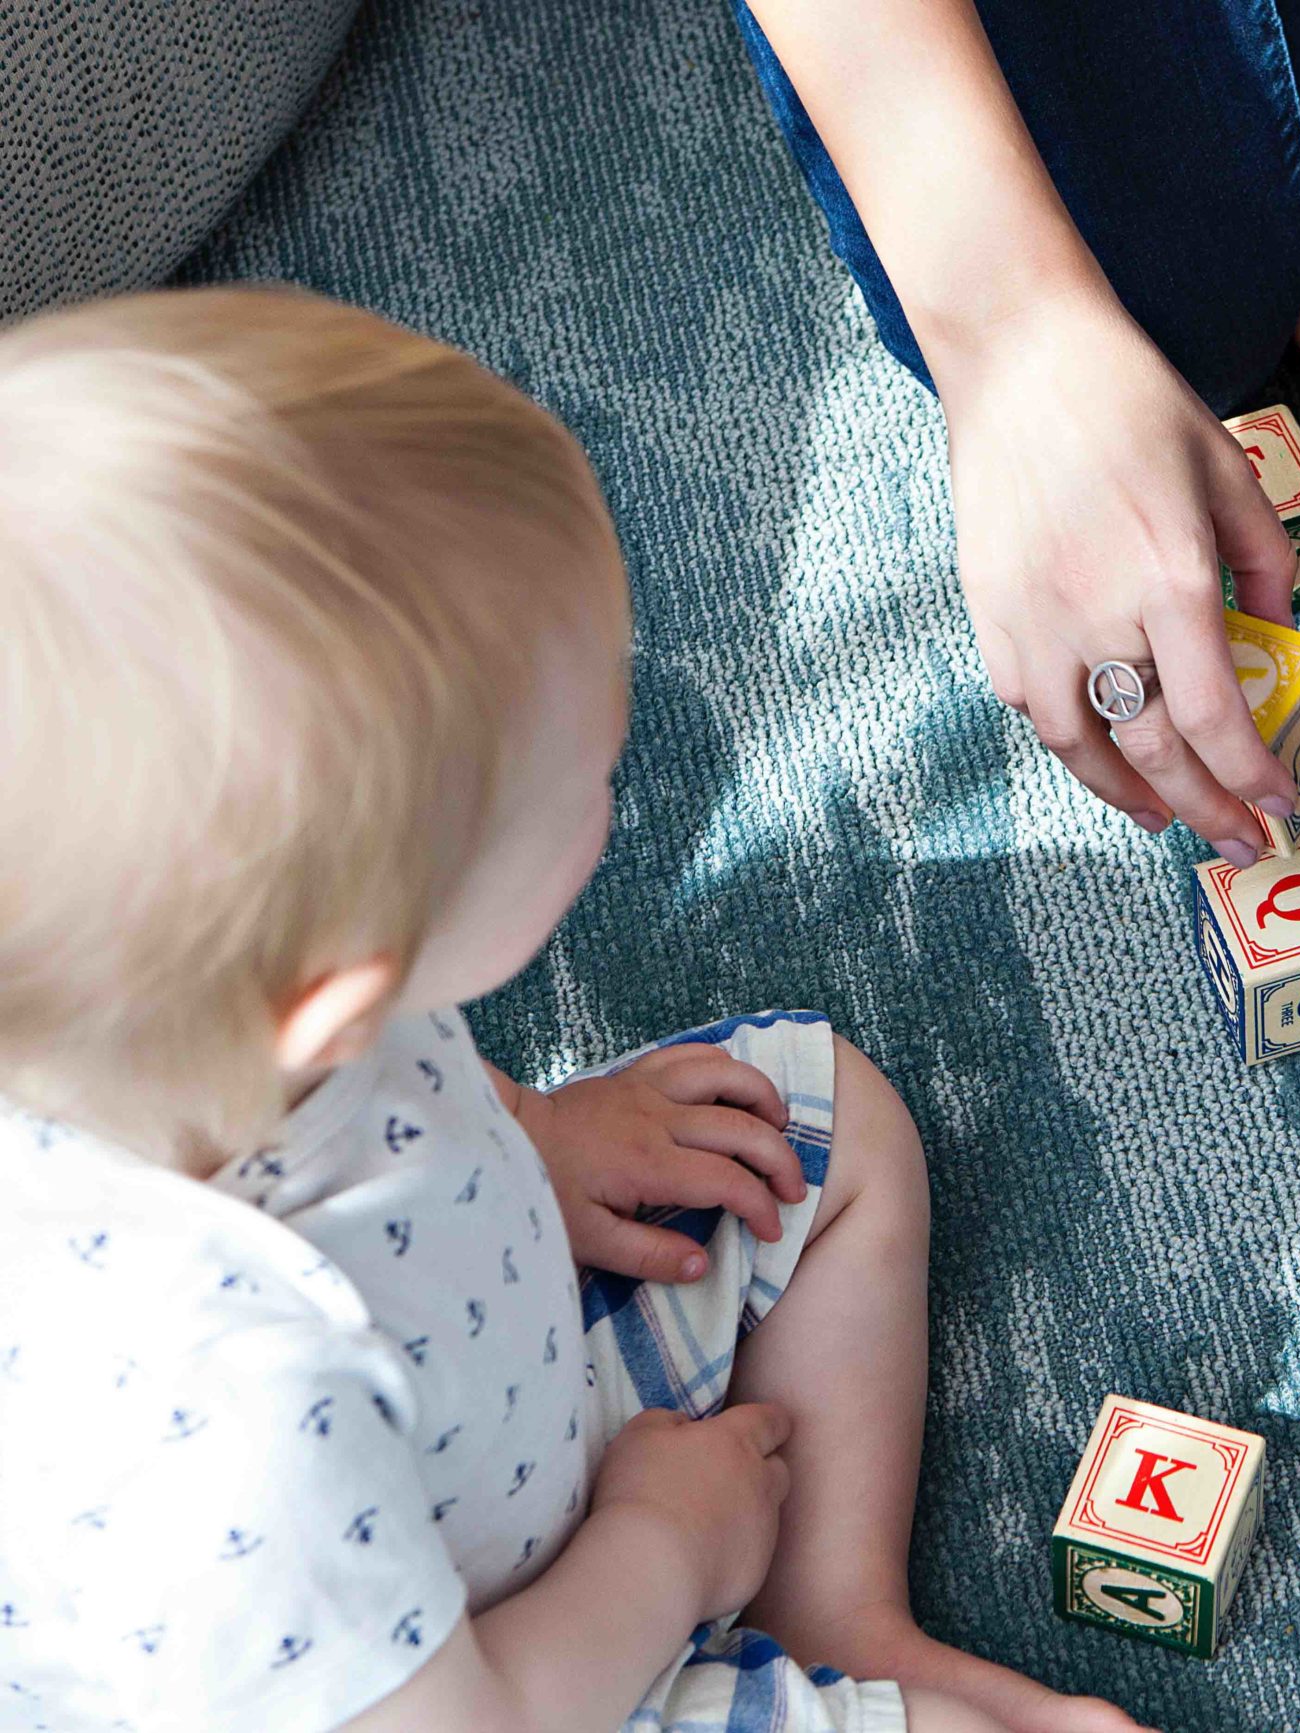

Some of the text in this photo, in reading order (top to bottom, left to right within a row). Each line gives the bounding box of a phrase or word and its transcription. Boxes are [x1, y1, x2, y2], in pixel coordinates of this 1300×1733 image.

[1281, 1001, 1294, 1028] THREE
[1115, 1448, 1197, 1523] K
[1101, 1584, 1166, 1621] A
